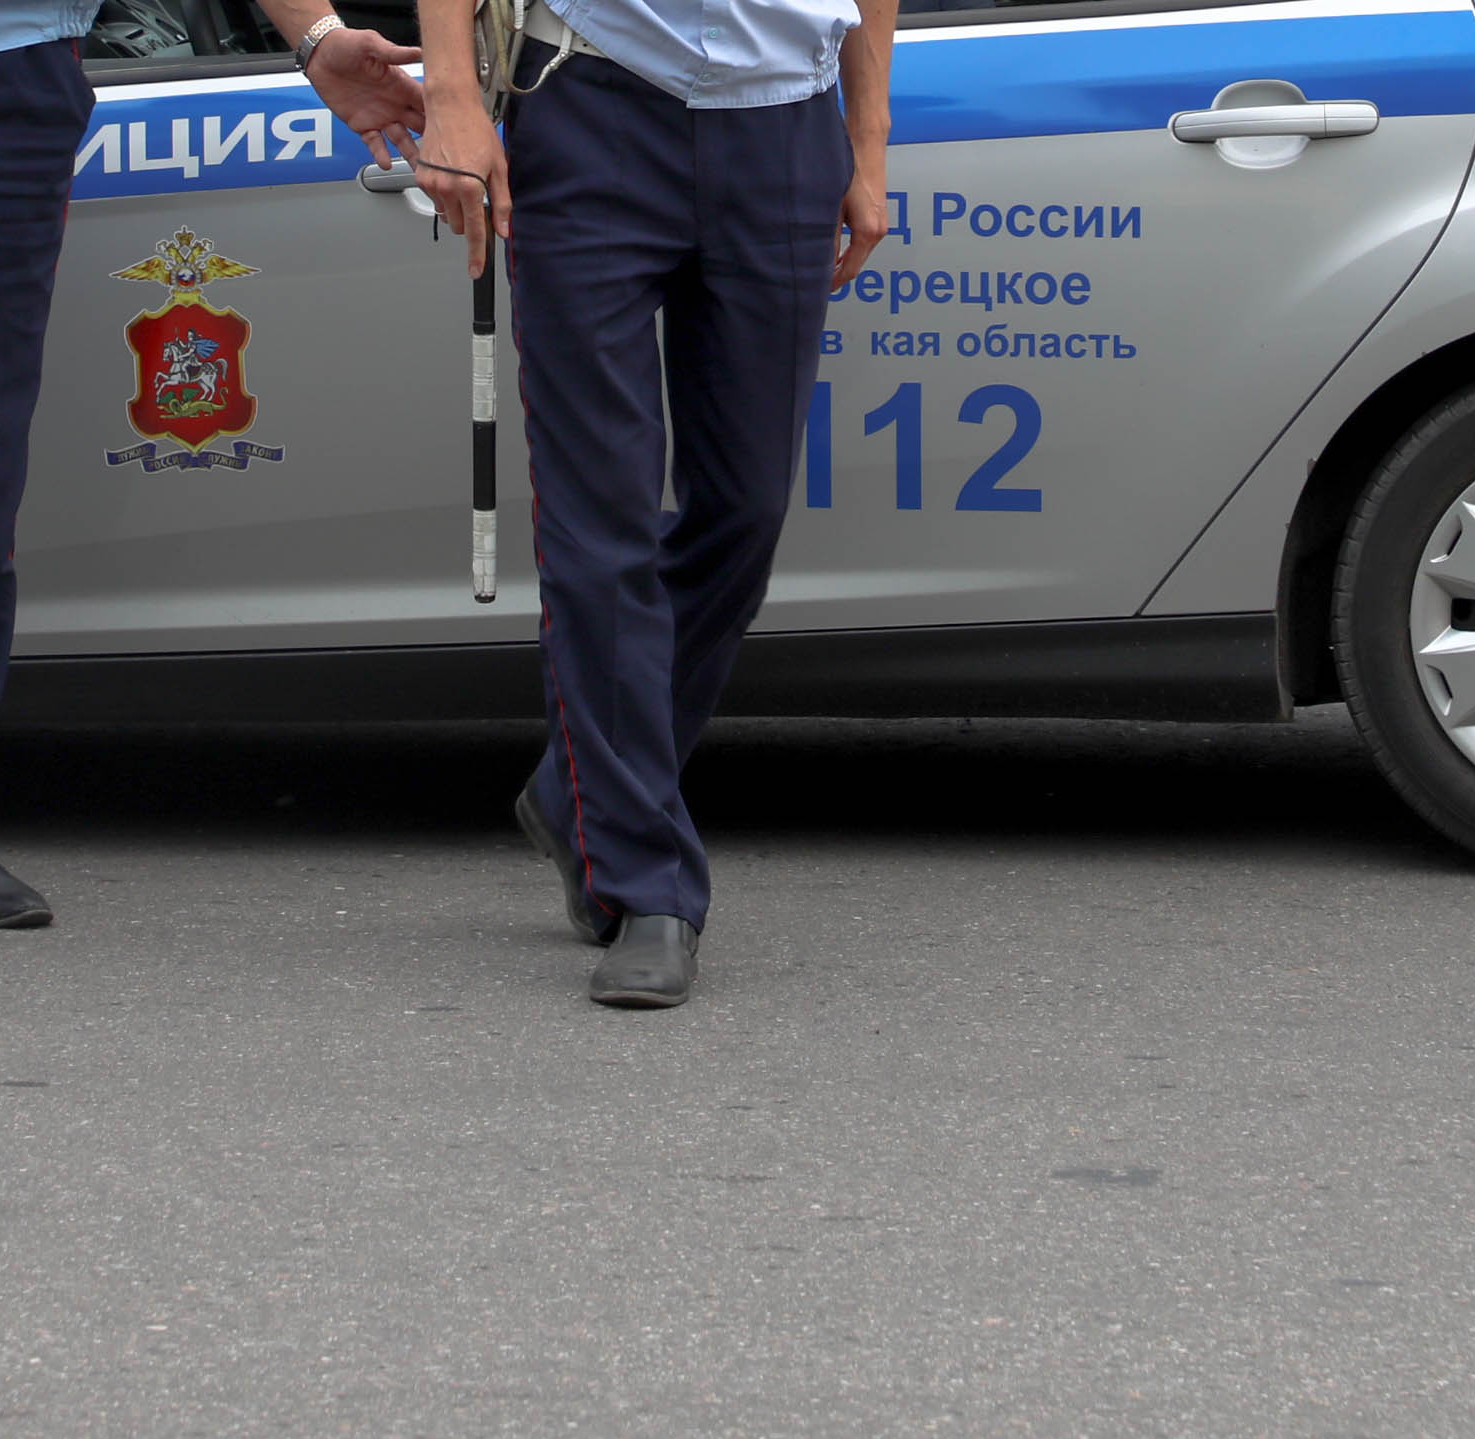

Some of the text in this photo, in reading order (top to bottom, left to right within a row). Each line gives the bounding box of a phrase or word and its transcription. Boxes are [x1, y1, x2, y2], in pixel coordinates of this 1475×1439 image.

[73, 108, 333, 179] ИЦИЯ
[932, 191, 1141, 239] России
[827, 268, 1092, 315] ерецкое
[956, 323, 1138, 359] область
[806, 381, 1043, 513] 112
